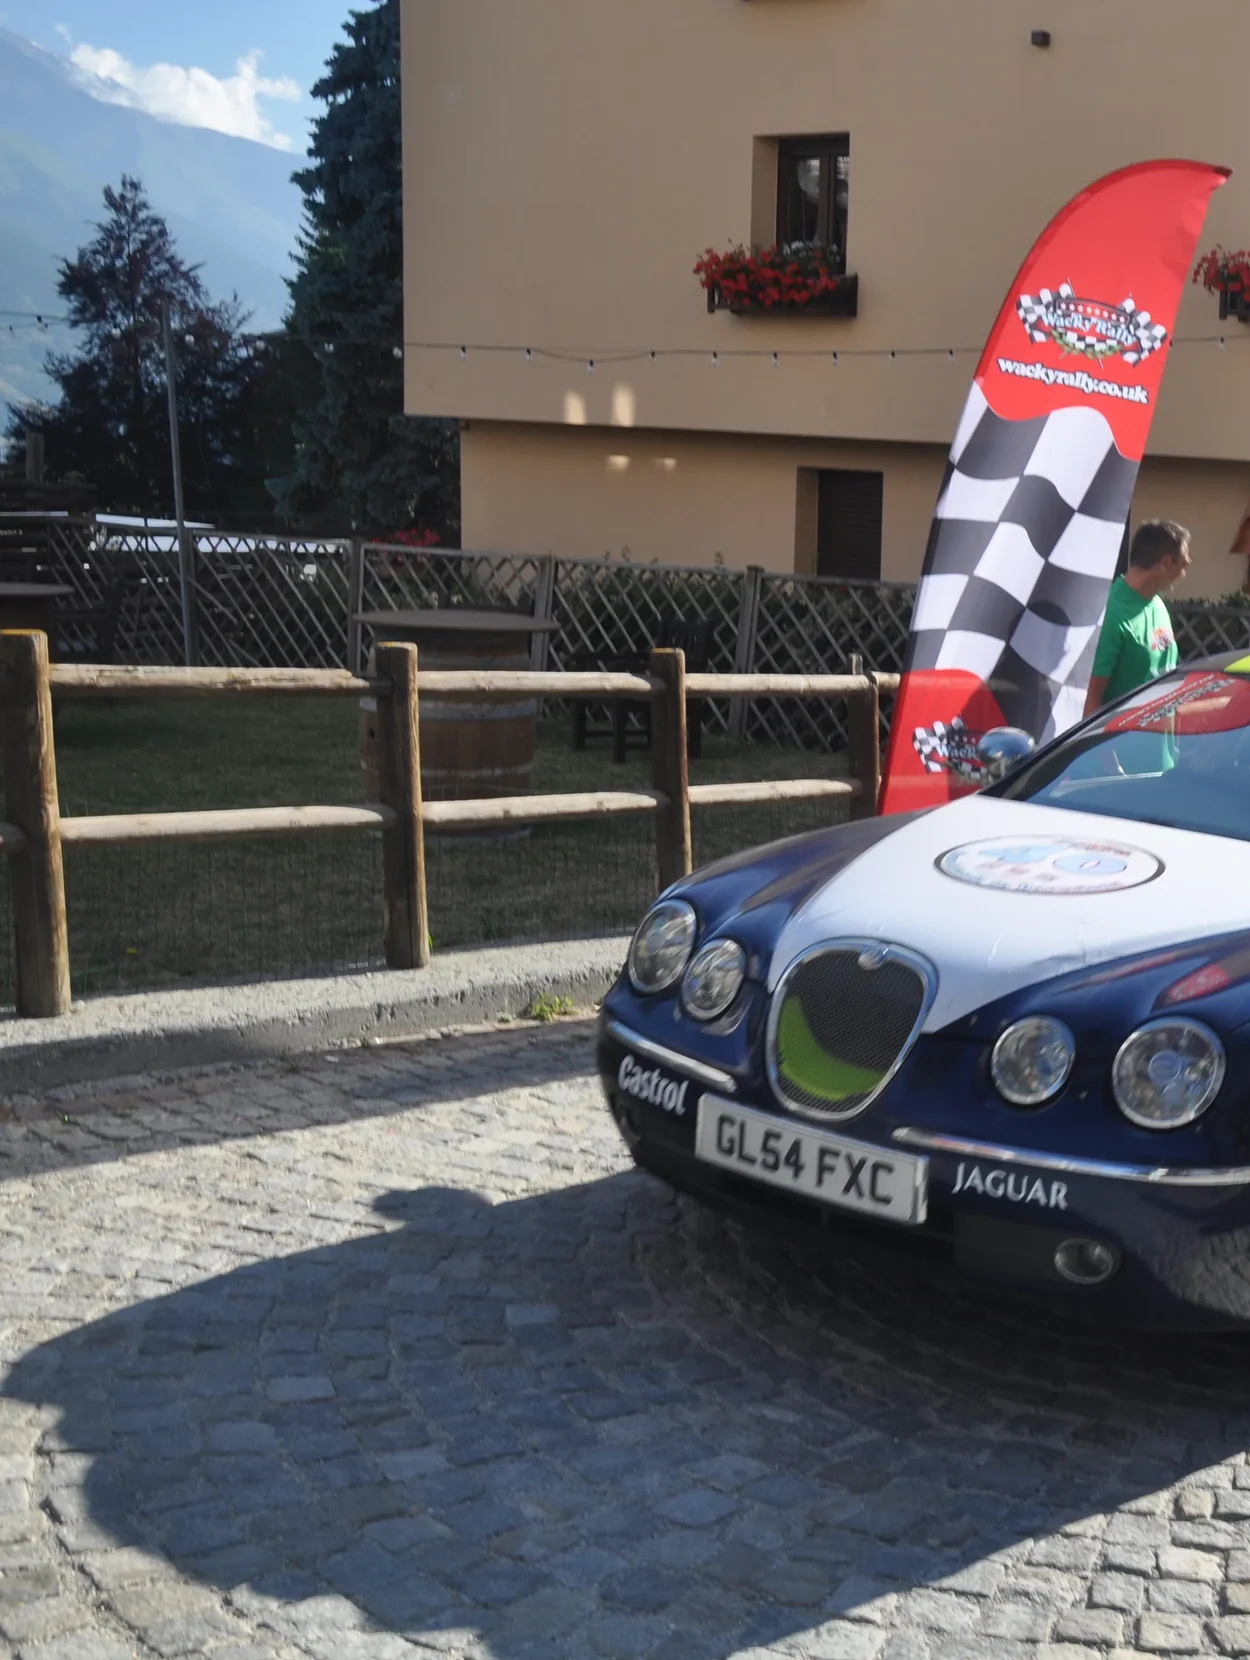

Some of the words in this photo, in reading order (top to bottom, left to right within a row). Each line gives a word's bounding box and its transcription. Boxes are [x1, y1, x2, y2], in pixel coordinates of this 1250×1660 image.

[1096, 317, 1136, 347] Rally
[997, 357, 1149, 404] wackyrally.co.uk
[936, 743, 980, 763] Wack
[618, 1054, 690, 1116] Castrol
[716, 1112, 804, 1181] GL54
[815, 1144, 896, 1207] FXC
[951, 1161, 1069, 1211] JAGUAR
